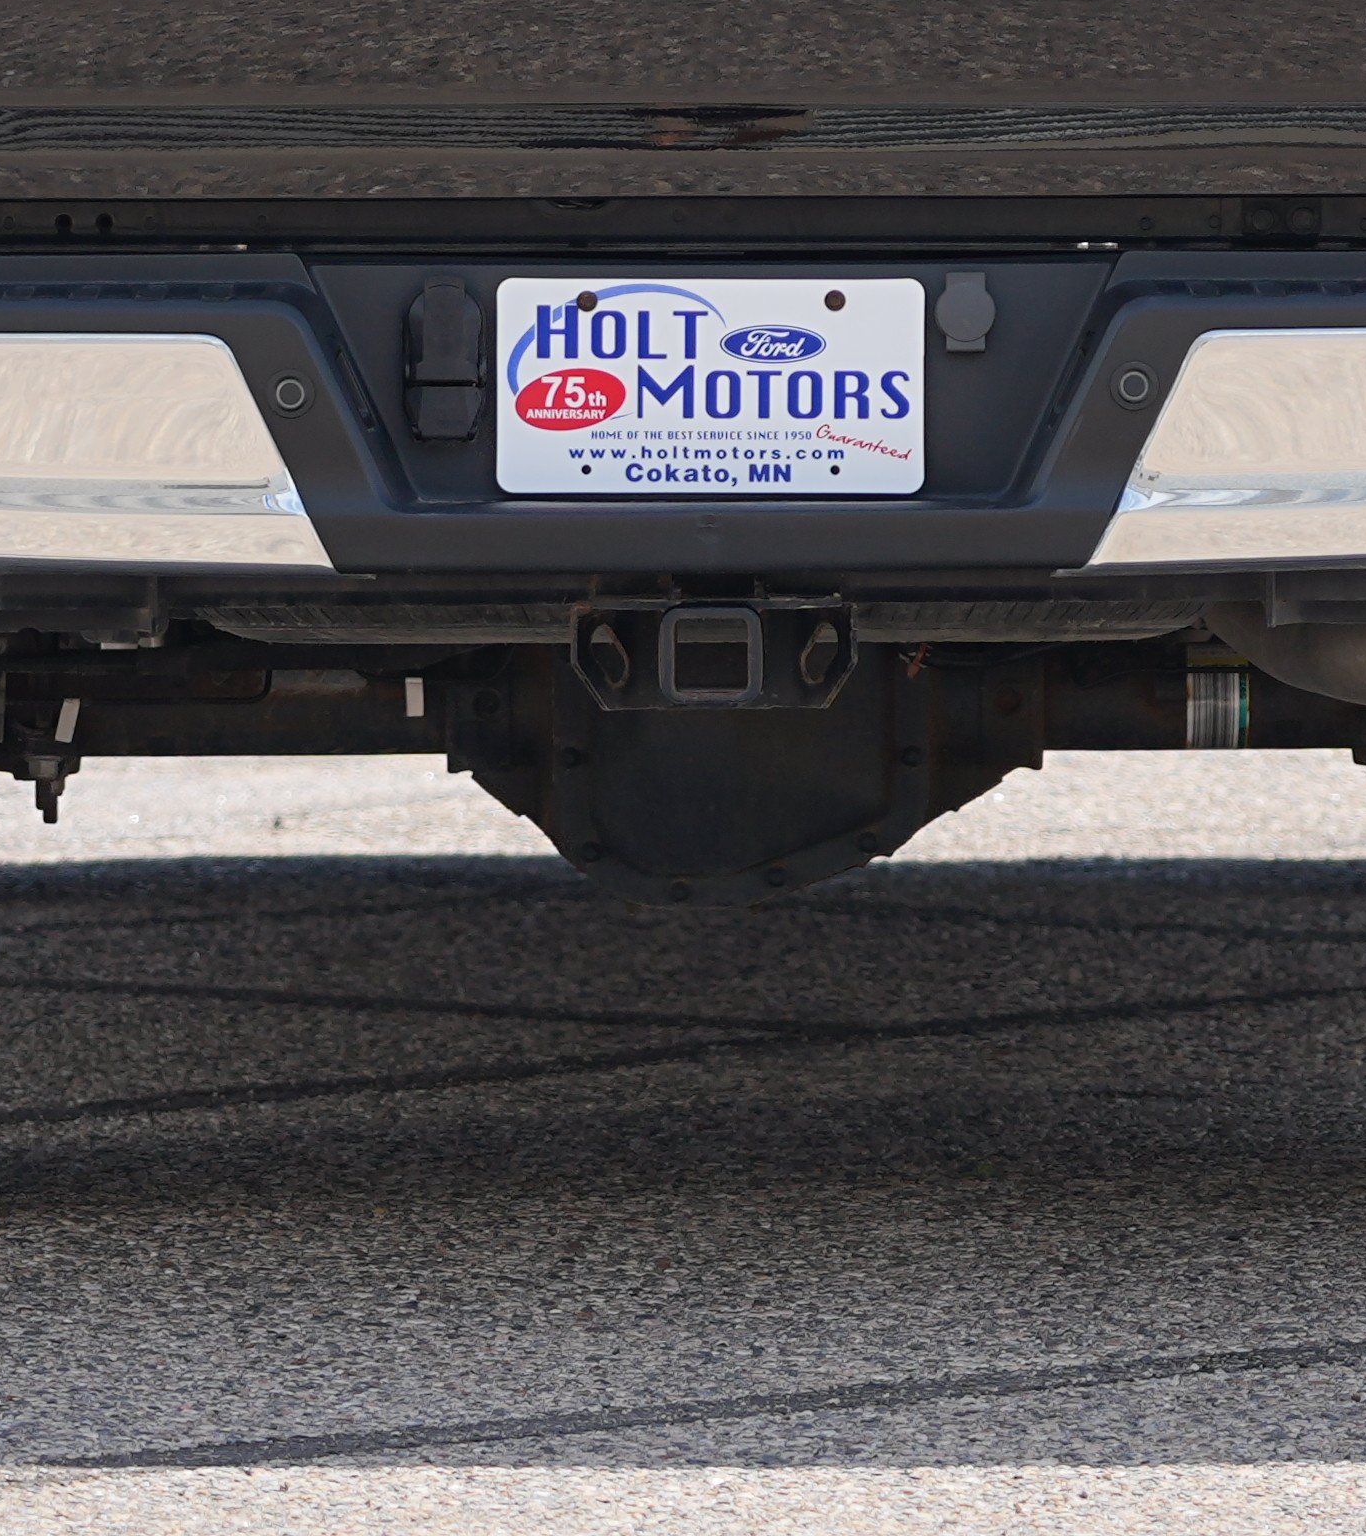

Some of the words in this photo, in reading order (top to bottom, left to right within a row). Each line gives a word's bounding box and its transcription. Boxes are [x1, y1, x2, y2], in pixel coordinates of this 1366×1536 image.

[536, 304, 709, 360] HOLT
[741, 329, 806, 359] Ford
[541, 375, 608, 409] 75th
[637, 364, 910, 420] MOTORS
[525, 408, 607, 420] ANNIVERSARY
[591, 430, 623, 441] HOME
[627, 430, 639, 441] OF
[643, 430, 663, 441] THE
[667, 430, 694, 441] BEST
[696, 430, 742, 441] SERVICE
[746, 430, 780, 441] SINCE
[784, 430, 813, 441] 1950
[816, 423, 912, 460] Guaranteed
[569, 445, 844, 461] www.holtmotors.com
[625, 464, 738, 486] Cokato,
[748, 464, 792, 482] MN
